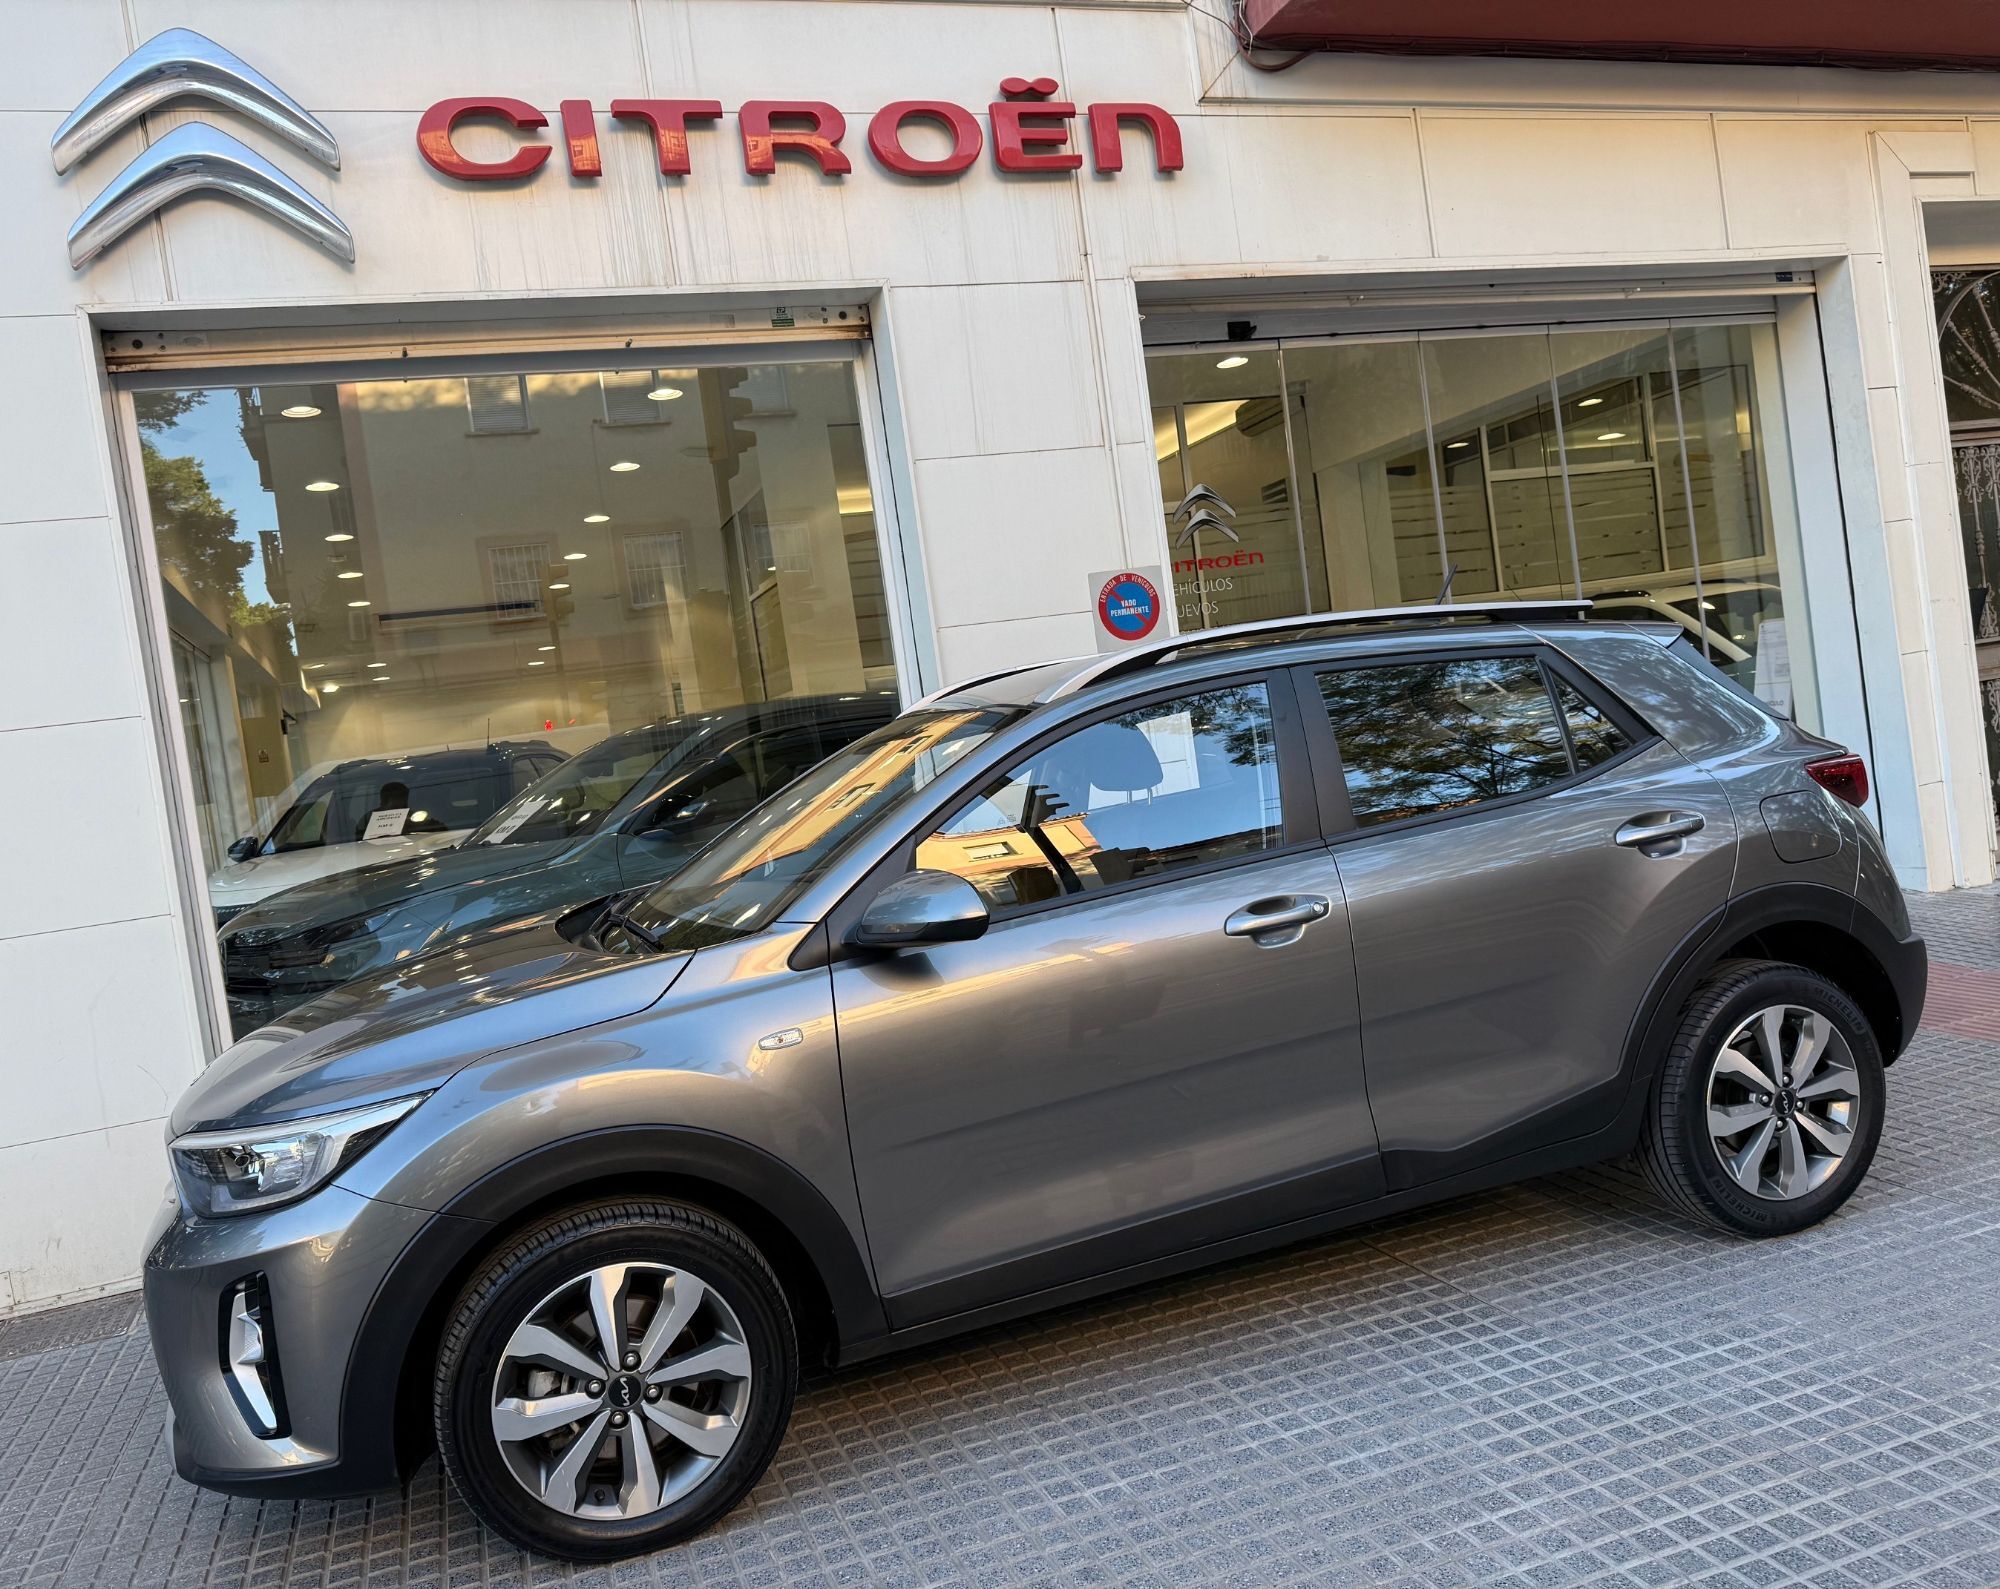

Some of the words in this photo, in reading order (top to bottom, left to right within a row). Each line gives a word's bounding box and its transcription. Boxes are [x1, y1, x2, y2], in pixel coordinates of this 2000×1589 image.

[417, 77, 1183, 180] CITROËN
[1171, 549, 1264, 573] ITROËN
[1100, 579, 1117, 603] ENTRADA
[1119, 574, 1127, 582] DE
[1173, 577, 1233, 597] EHÍCULOS
[1110, 605, 1149, 617] PERMANENTE
[1120, 598, 1136, 608] VADO
[1176, 601, 1219, 618] UEVOS
[1814, 986, 1865, 1032] MICHELIN
[1711, 1178, 1769, 1222] MICHELIN
